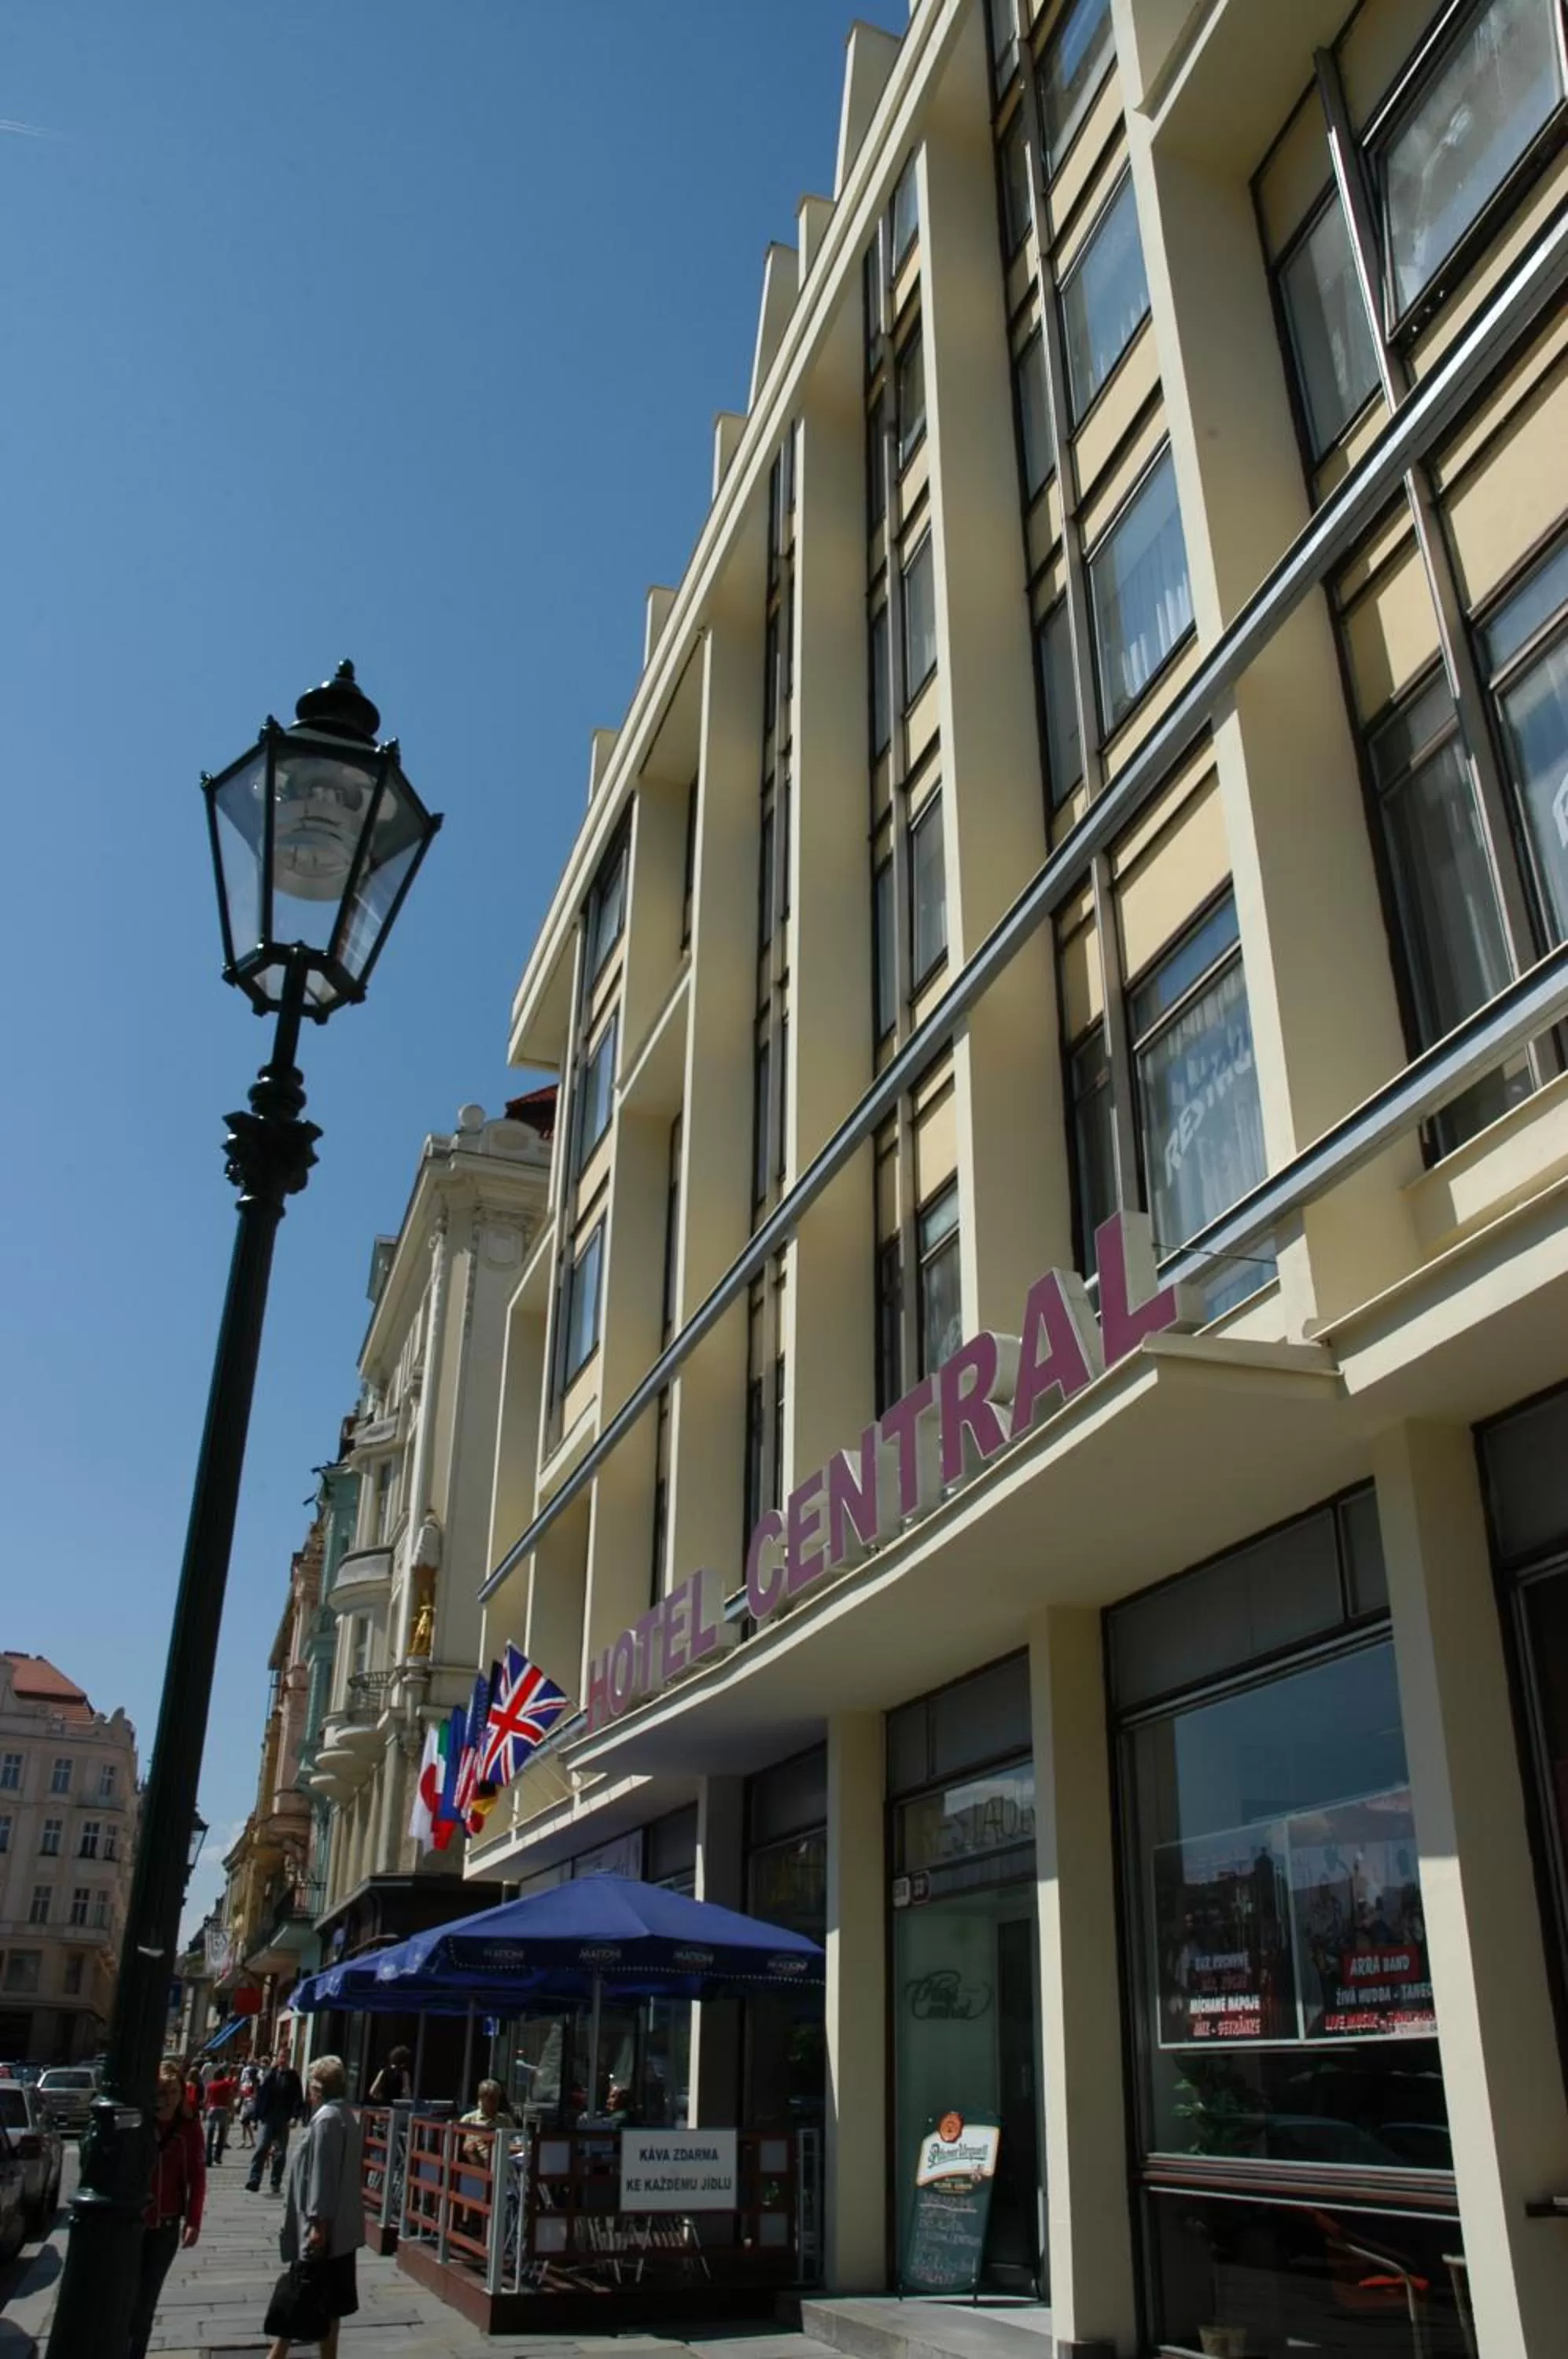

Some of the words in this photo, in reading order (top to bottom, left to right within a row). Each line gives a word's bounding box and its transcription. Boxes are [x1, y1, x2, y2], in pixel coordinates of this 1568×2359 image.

[587, 1570, 719, 1732] HOTEL
[747, 1211, 1180, 1621] CENTRAL
[639, 2144, 671, 2162] KÁVA
[672, 2147, 719, 2162] ZDARMA
[626, 2177, 642, 2192] KE
